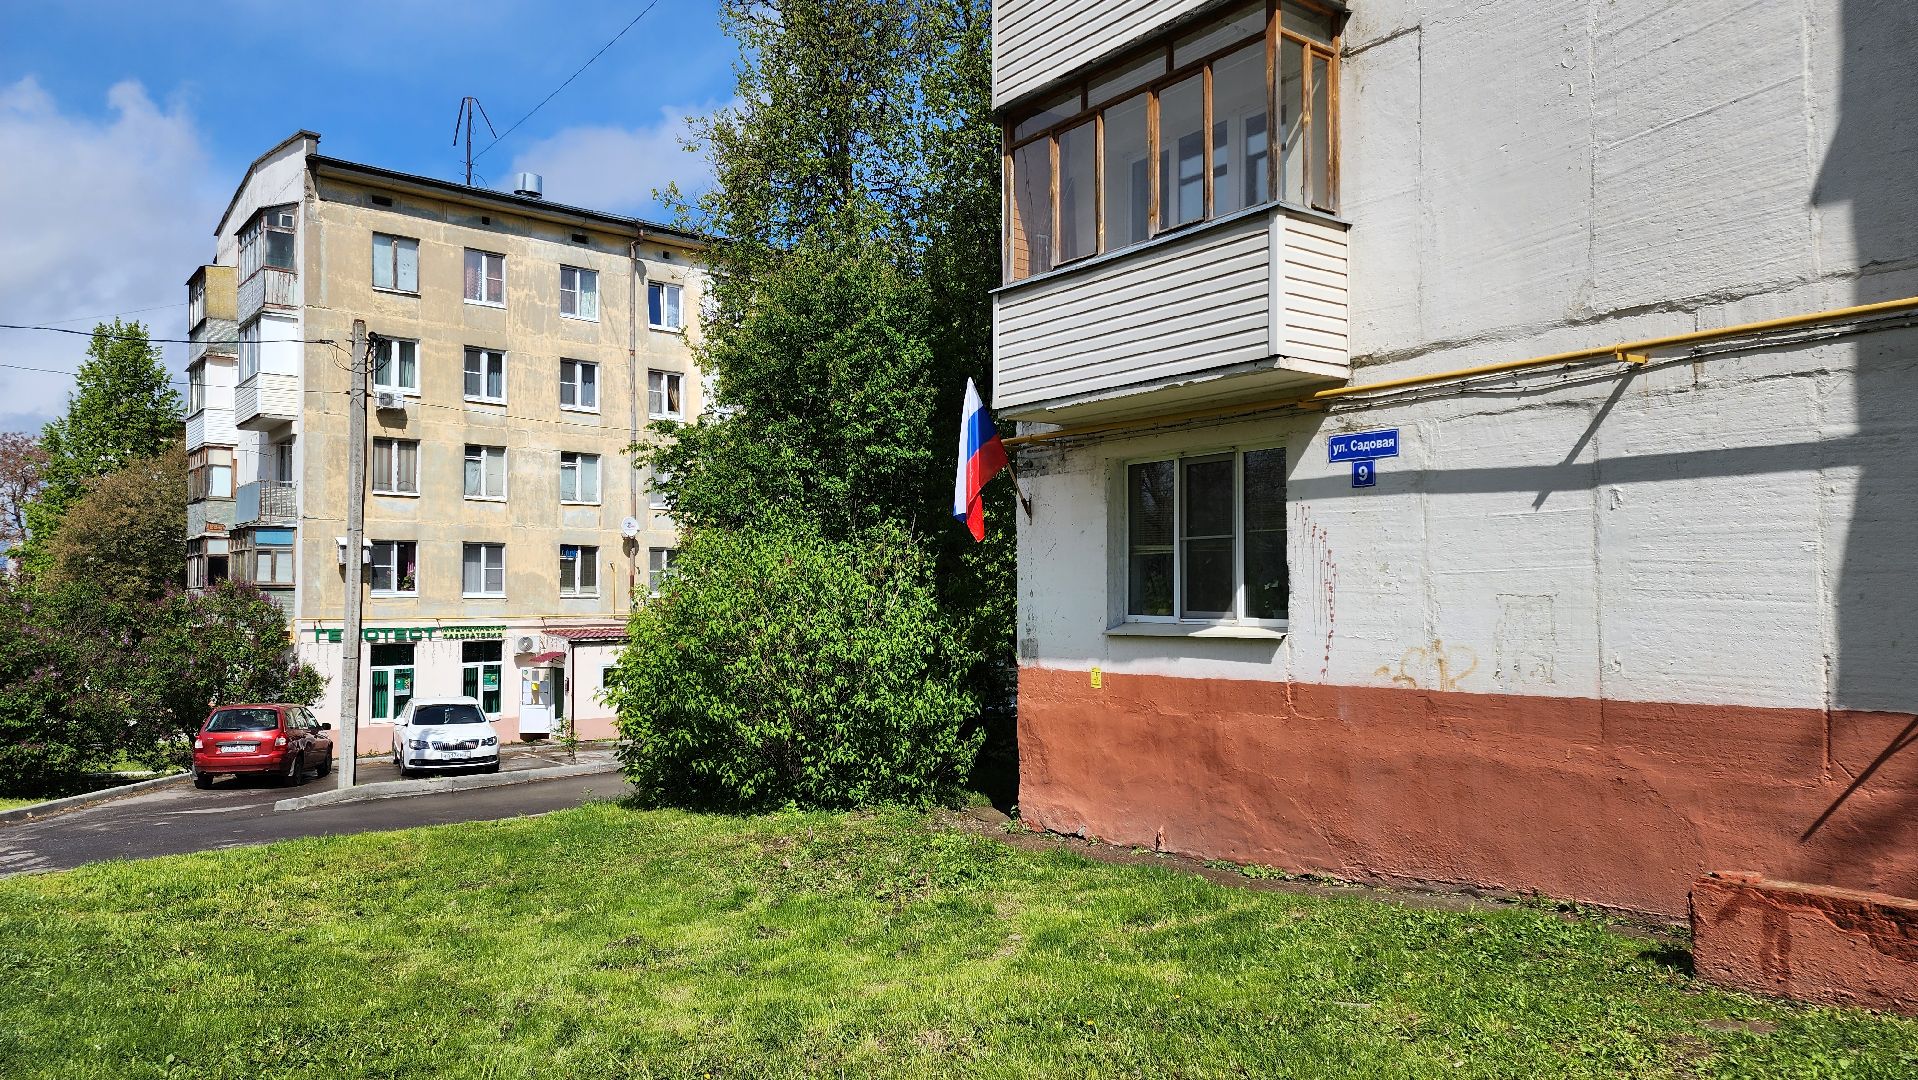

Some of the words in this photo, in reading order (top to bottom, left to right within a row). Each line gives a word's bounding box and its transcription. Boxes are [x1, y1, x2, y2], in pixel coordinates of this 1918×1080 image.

[1333, 443, 1348, 456] ул.
[1350, 438, 1395, 452] Садовая
[1358, 465, 1368, 481] 9
[315, 627, 436, 643] ГЕОТЕСТ
